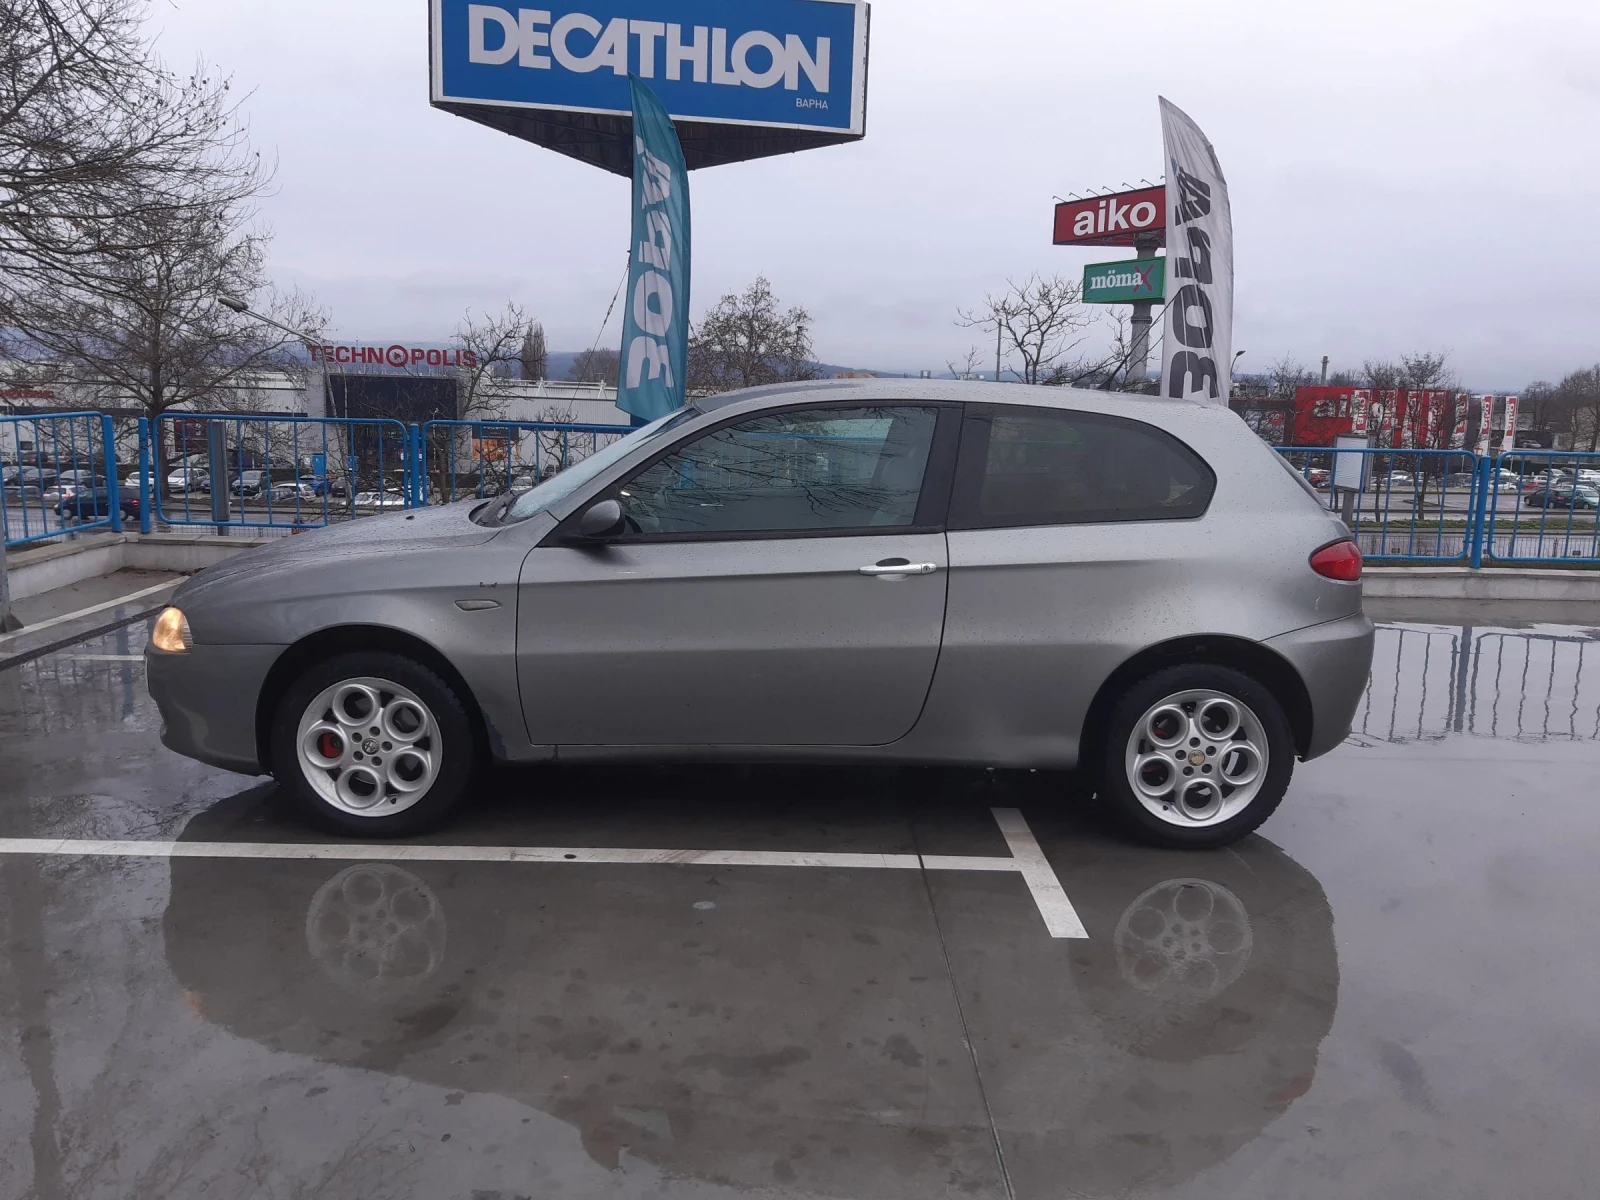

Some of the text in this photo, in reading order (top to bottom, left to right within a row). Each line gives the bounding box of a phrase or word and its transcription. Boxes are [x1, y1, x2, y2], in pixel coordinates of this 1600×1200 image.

[468, 4, 831, 93] DECATHLON
[795, 97, 829, 110] ВАРНА
[1073, 198, 1157, 237] aiko
[310, 344, 477, 368] TECHNOPOLIS
